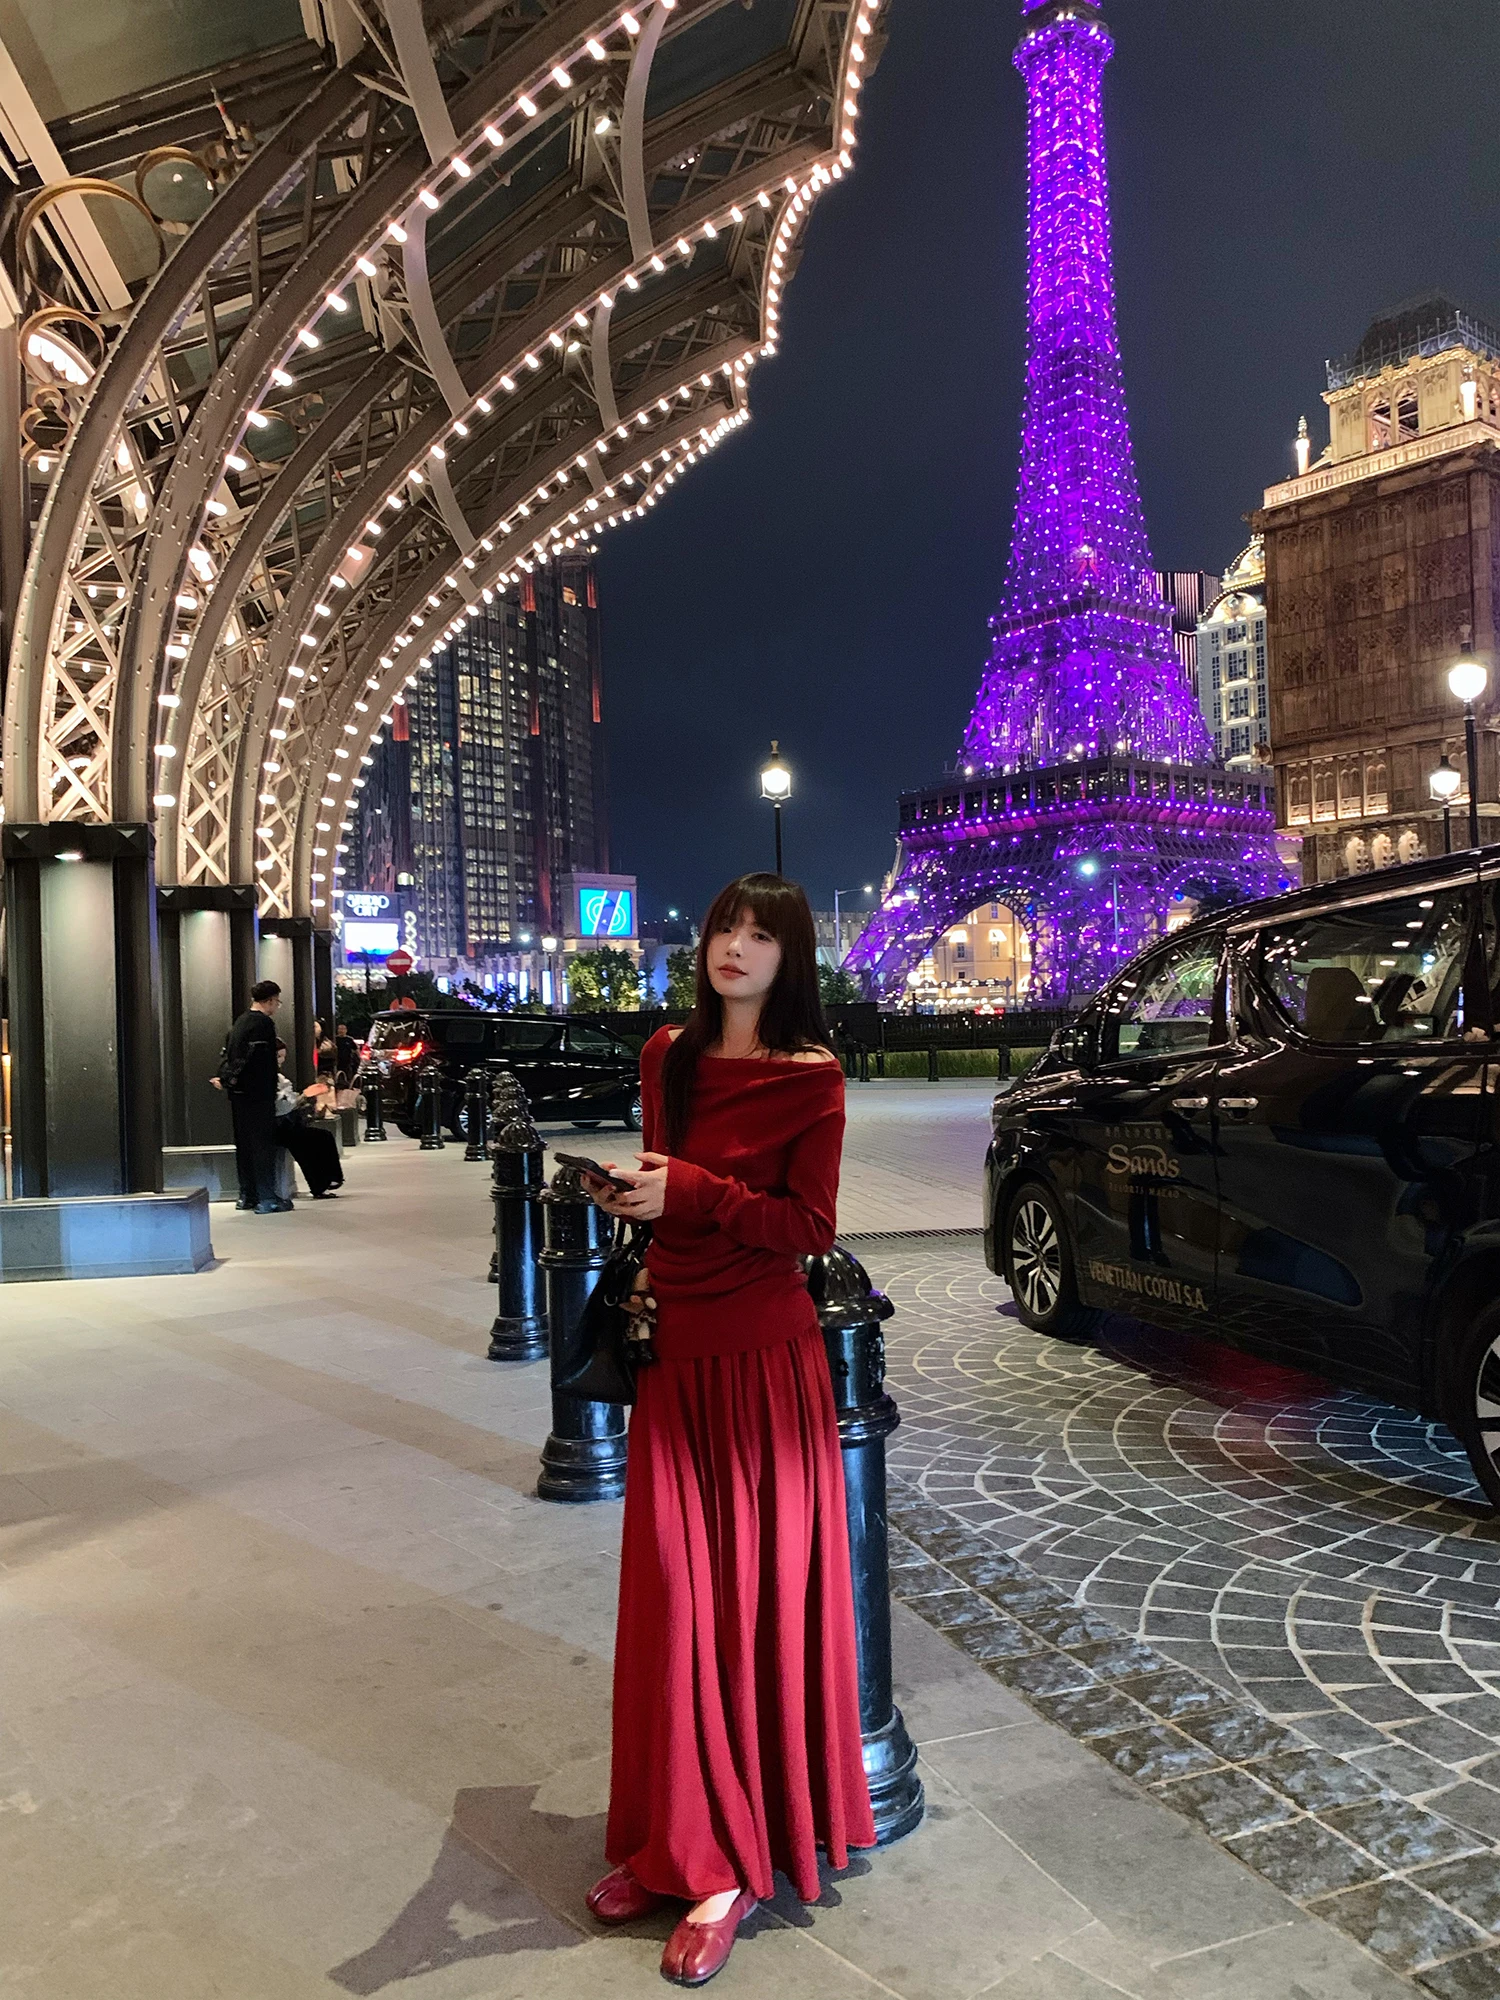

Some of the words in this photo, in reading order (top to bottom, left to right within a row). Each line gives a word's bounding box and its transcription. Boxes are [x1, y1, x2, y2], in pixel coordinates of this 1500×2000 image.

[1106, 1143, 1181, 1178] Sands
[1088, 1260, 1143, 1294] VENETIAN
[1143, 1275, 1183, 1305] COTAI
